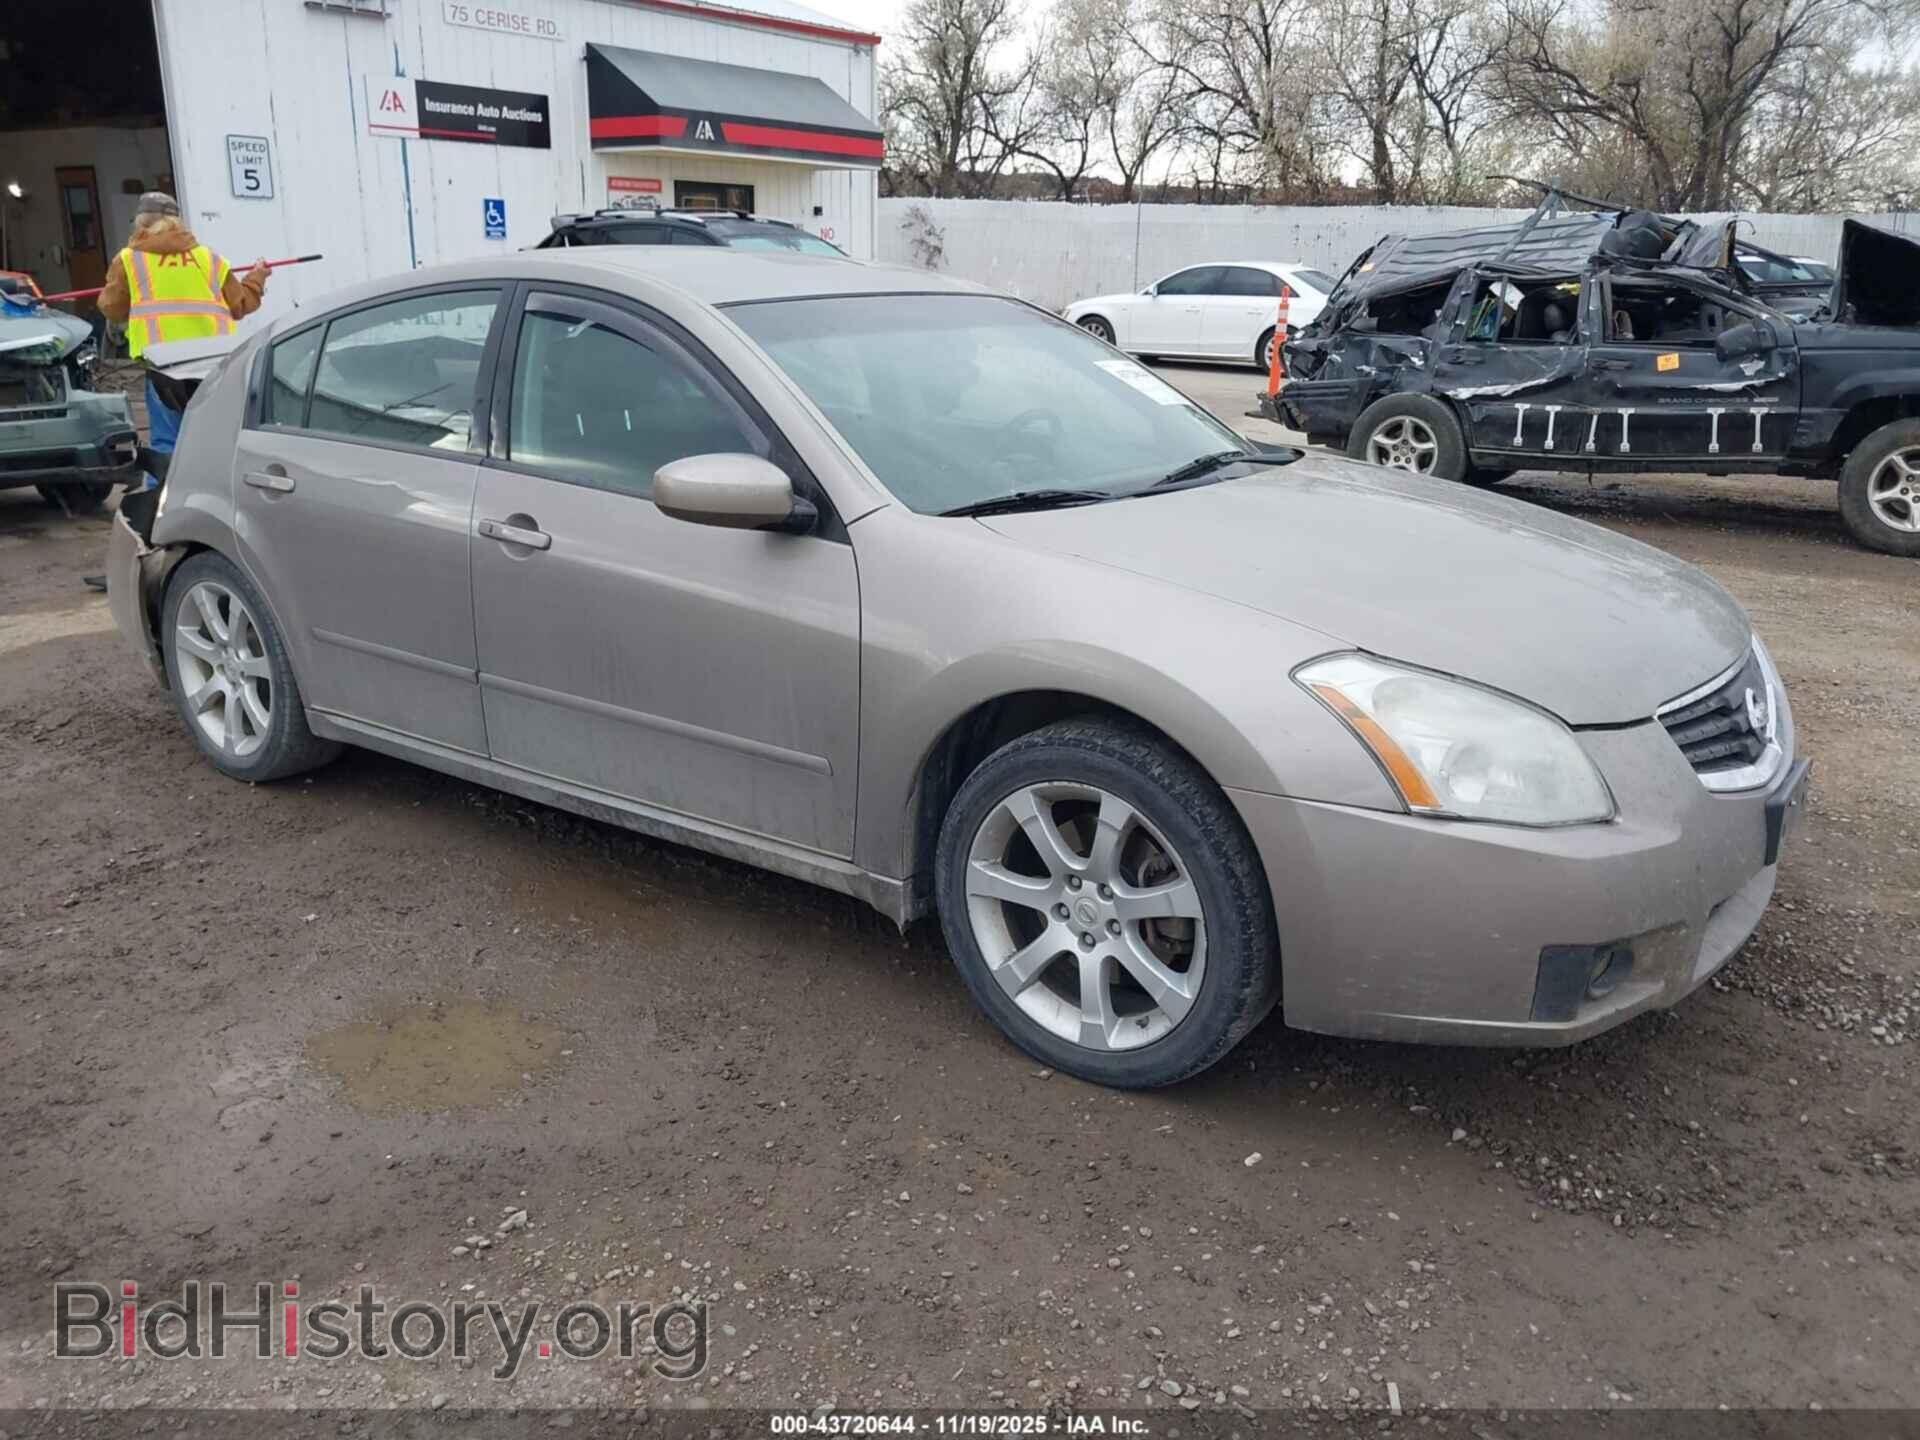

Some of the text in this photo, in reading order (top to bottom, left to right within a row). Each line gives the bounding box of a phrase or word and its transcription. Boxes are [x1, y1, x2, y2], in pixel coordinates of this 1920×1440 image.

[450, 4, 561, 37] 75 CERISE RD.
[425, 98, 543, 123] Insurance Auto Auctions
[230, 141, 266, 153] SPEED
[235, 155, 264, 165] LIMIT
[244, 169, 260, 191] 5
